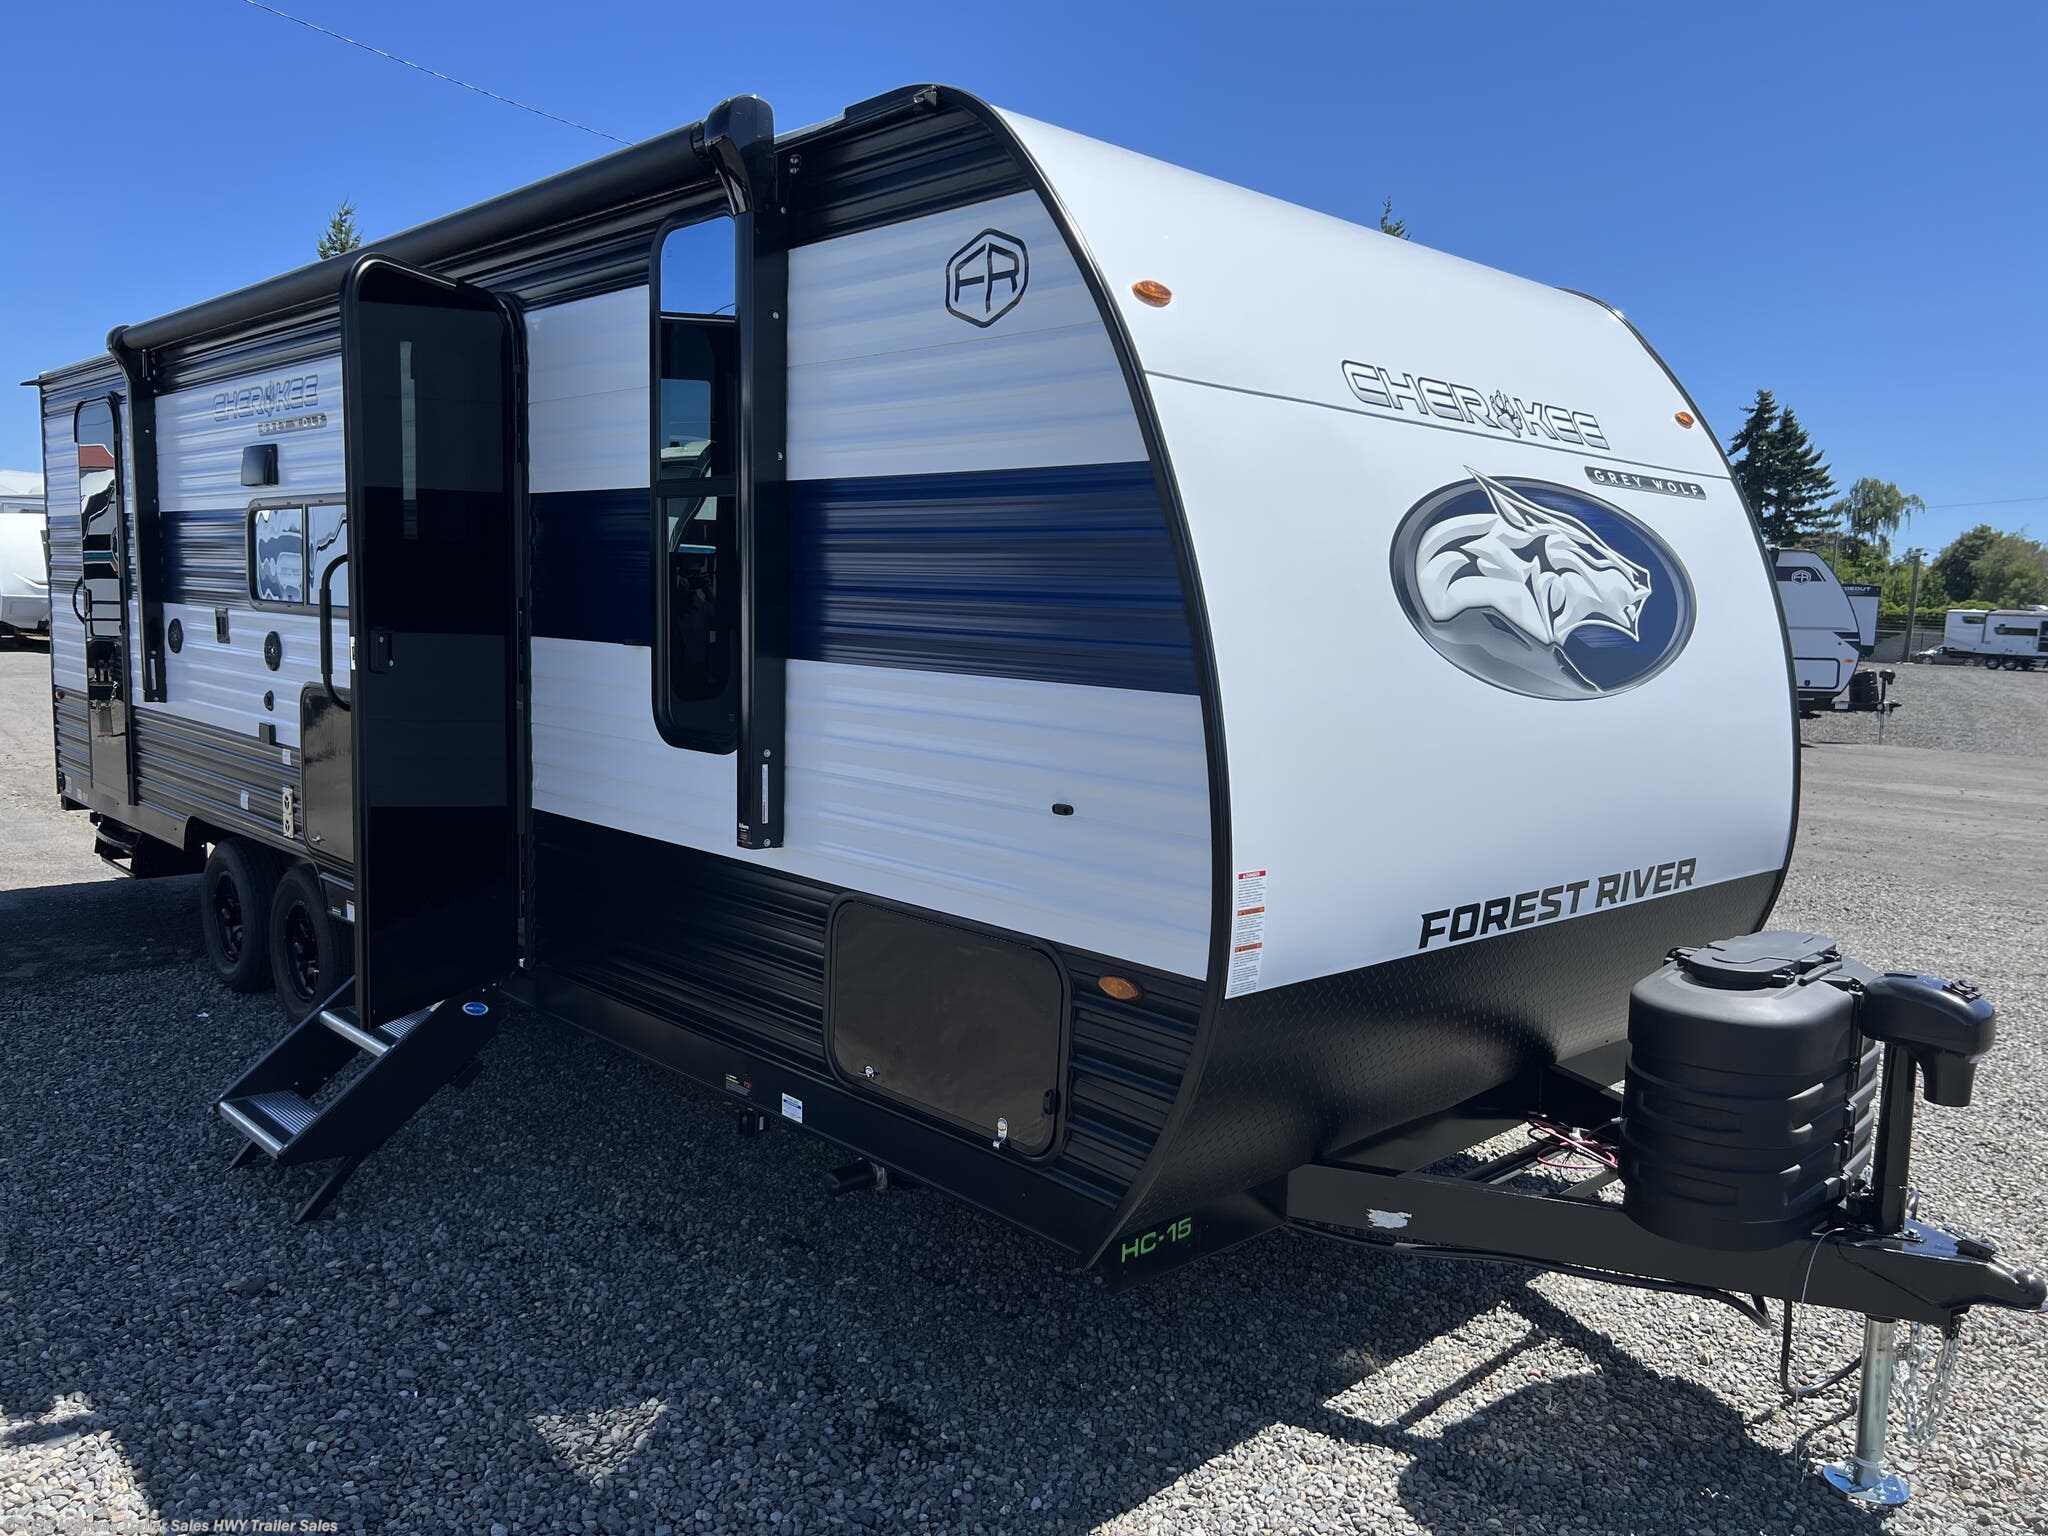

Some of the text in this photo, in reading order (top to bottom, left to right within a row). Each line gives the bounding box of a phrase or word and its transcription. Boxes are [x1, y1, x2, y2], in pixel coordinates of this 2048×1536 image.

[293, 415, 321, 427] WOLF
[1341, 360, 1610, 450] CHEROKEE
[1594, 469, 1698, 496] GREY WOLF
[1418, 857, 1697, 950] FOREST RIVER
[1121, 1217, 1192, 1263] HC-15
